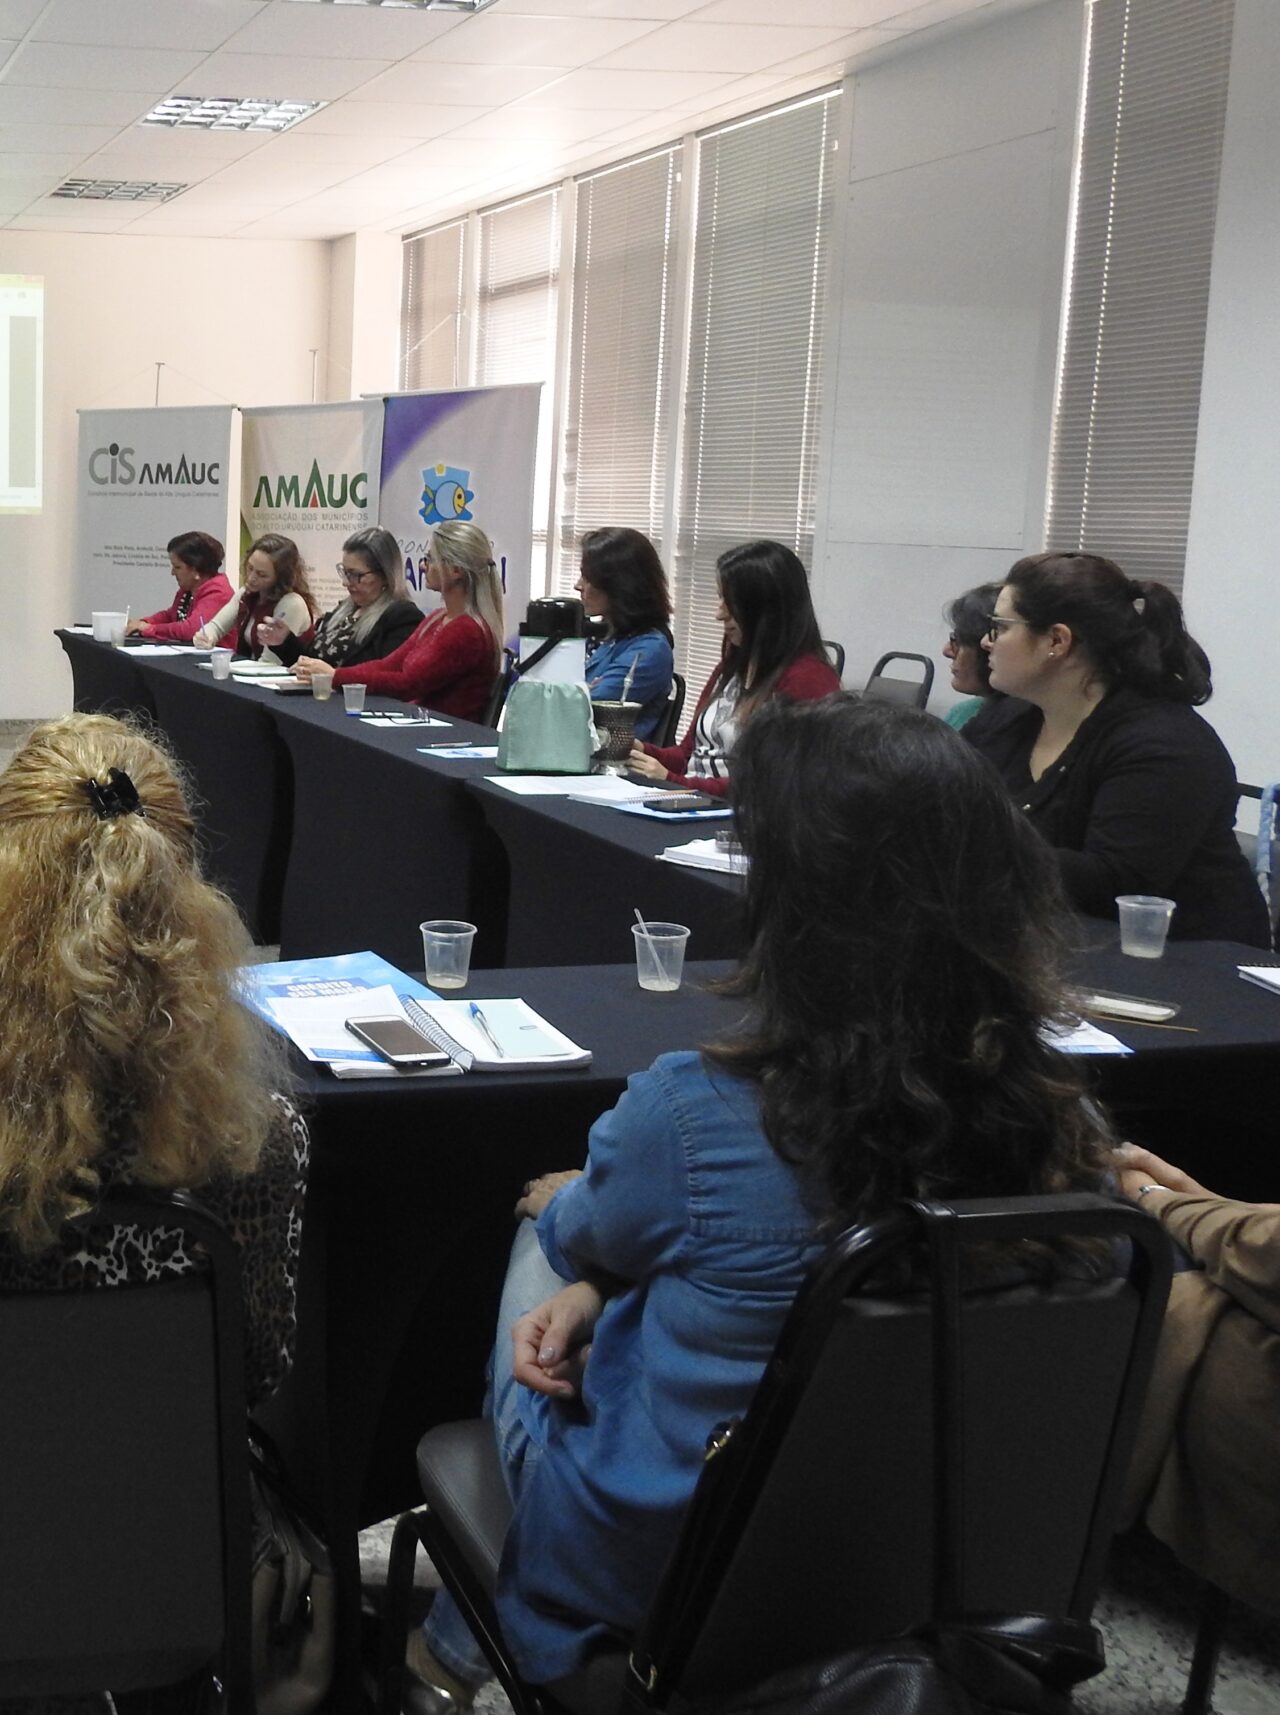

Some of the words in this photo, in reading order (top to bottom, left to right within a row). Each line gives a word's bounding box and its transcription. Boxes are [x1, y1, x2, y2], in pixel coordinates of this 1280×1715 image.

[139, 453, 219, 485] AMAUC
[253, 458, 368, 508] AMAUC
[302, 513, 317, 521] DOS
